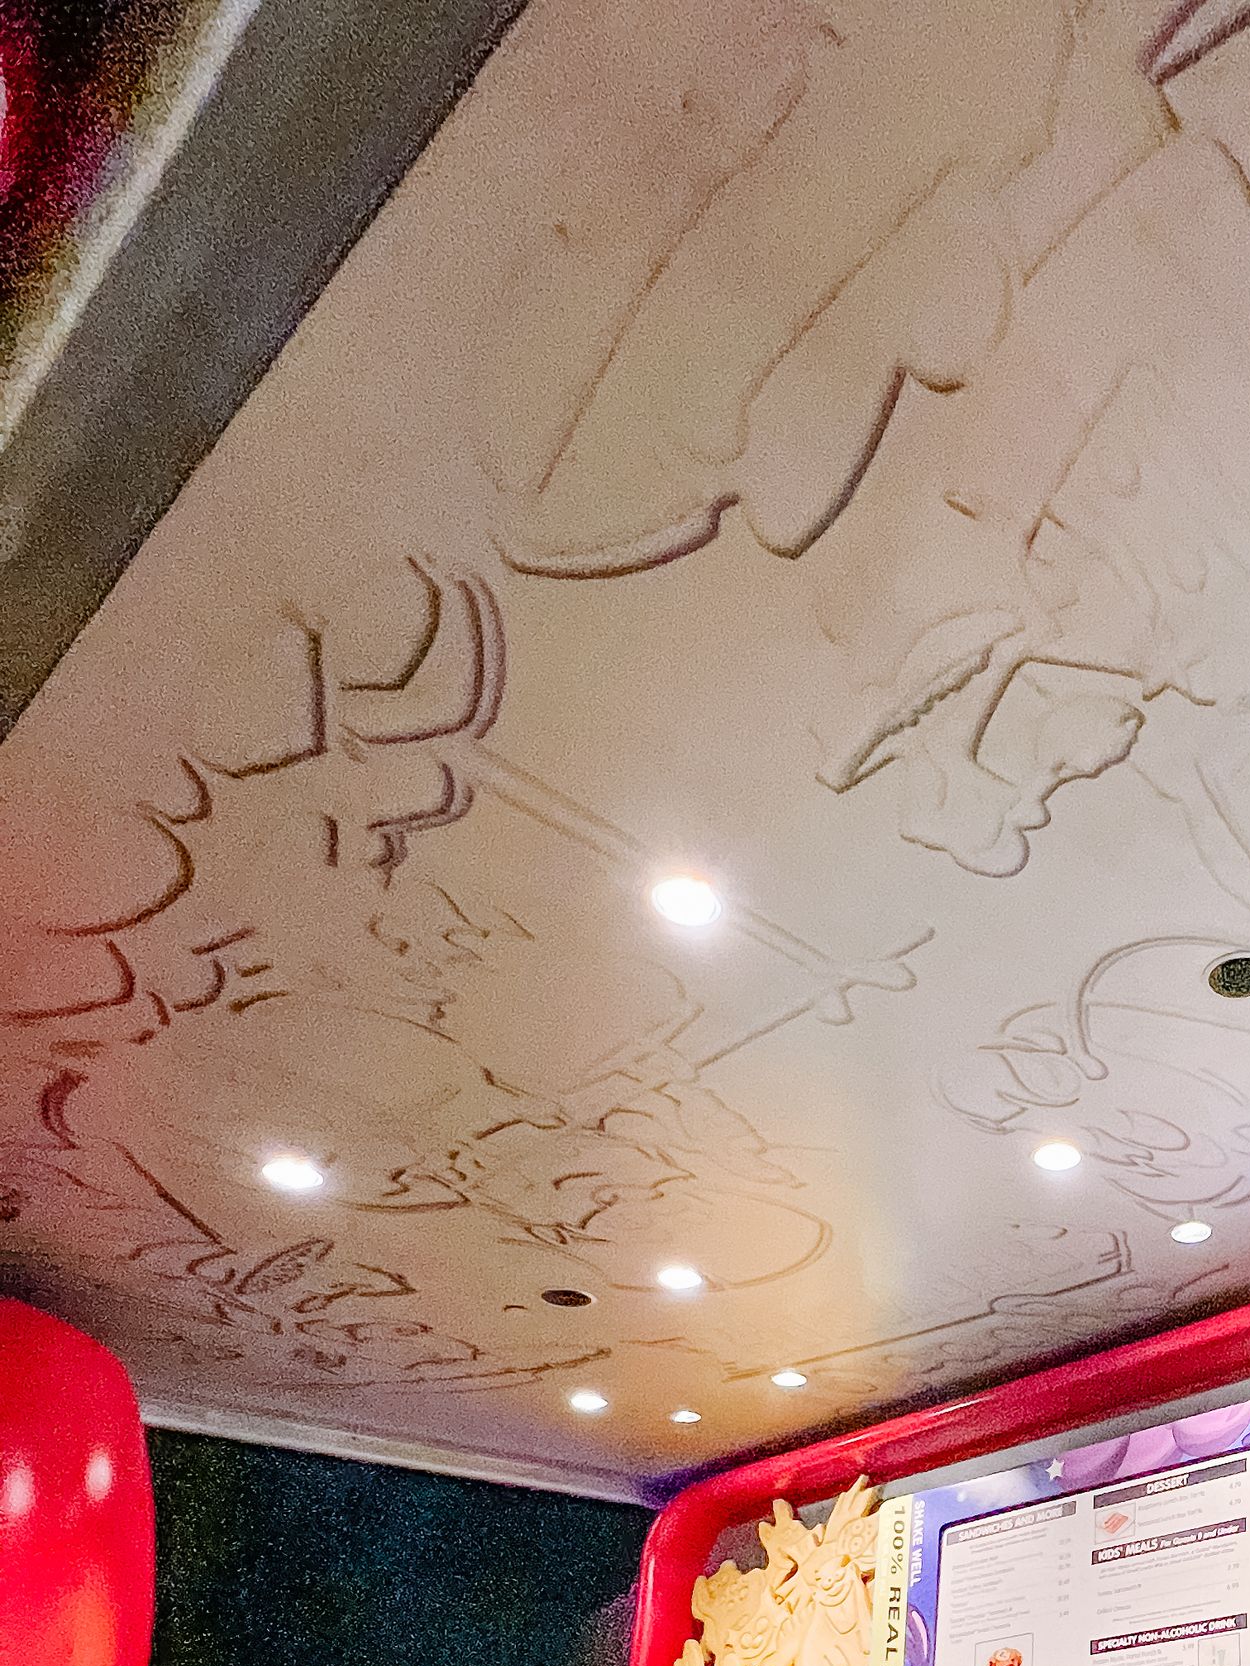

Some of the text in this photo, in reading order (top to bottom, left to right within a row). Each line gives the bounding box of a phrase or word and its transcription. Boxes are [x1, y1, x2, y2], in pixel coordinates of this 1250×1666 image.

[1146, 1474, 1189, 1494] DESSERT
[889, 1505, 906, 1575] 100%
[959, 1519, 1014, 1542] SANDWICHES
[1014, 1514, 1035, 1528] AND
[1035, 1505, 1063, 1522] MORE
[909, 1500, 925, 1588] SHAKE WELL
[1098, 1546, 1124, 1562] KIDS'
[1125, 1538, 1158, 1556] MEALS
[1203, 1528, 1217, 1539] and
[884, 1586, 901, 1662] REAL
[1098, 1617, 1237, 1651] SPECIALTY NON-ALCOHOLIC DRINK
